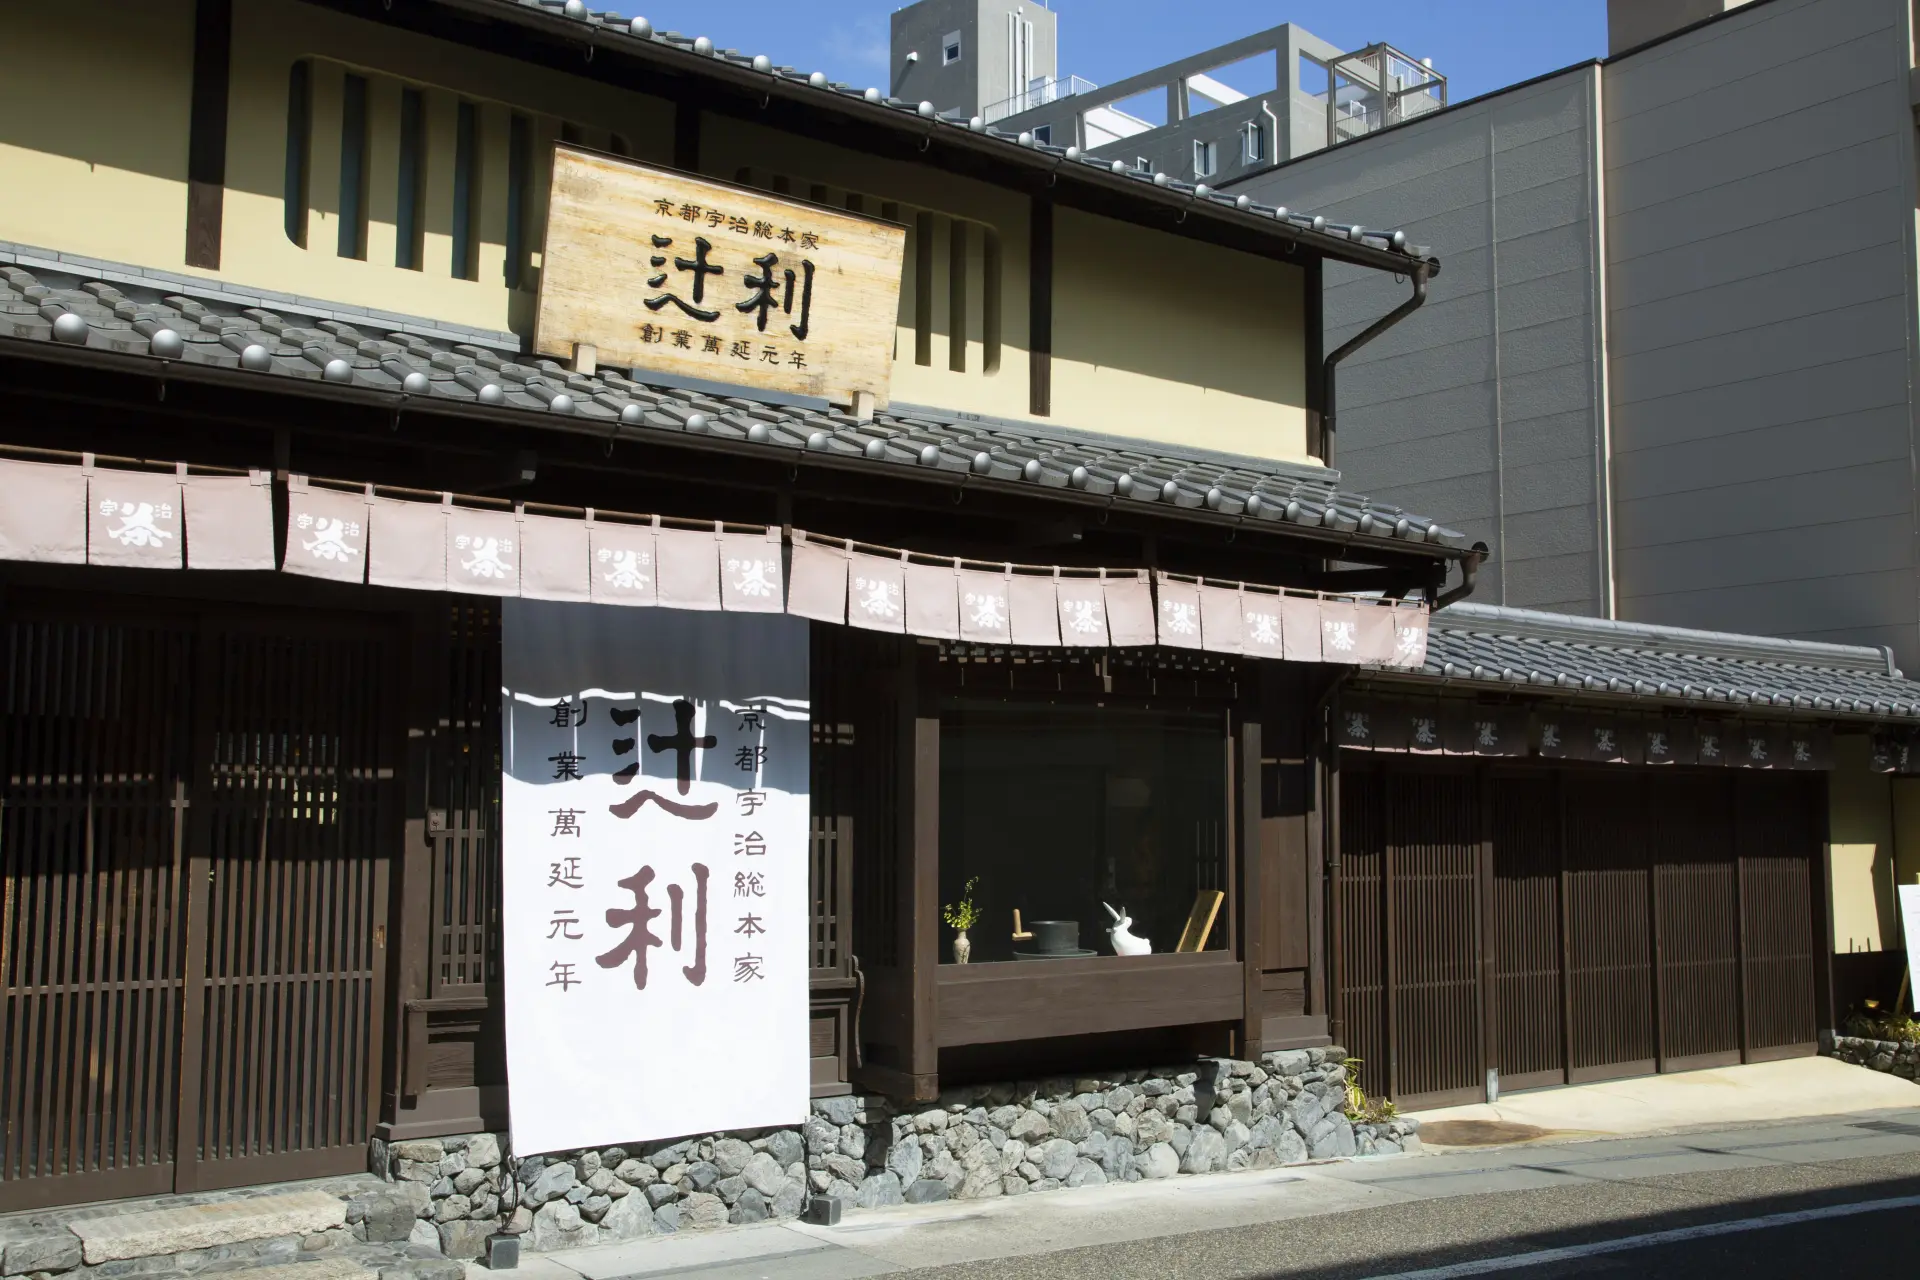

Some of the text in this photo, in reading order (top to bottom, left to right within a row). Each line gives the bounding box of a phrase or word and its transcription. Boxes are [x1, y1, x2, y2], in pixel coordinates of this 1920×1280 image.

[643, 235, 815, 341] 辻利
[653, 198, 820, 251] 京都宇治総本家
[639, 324, 807, 370] 創業萬延元年
[546, 698, 588, 992] 創業萬延元年
[596, 699, 718, 990] 辻利
[733, 705, 768, 983] 京都宇治総本家
